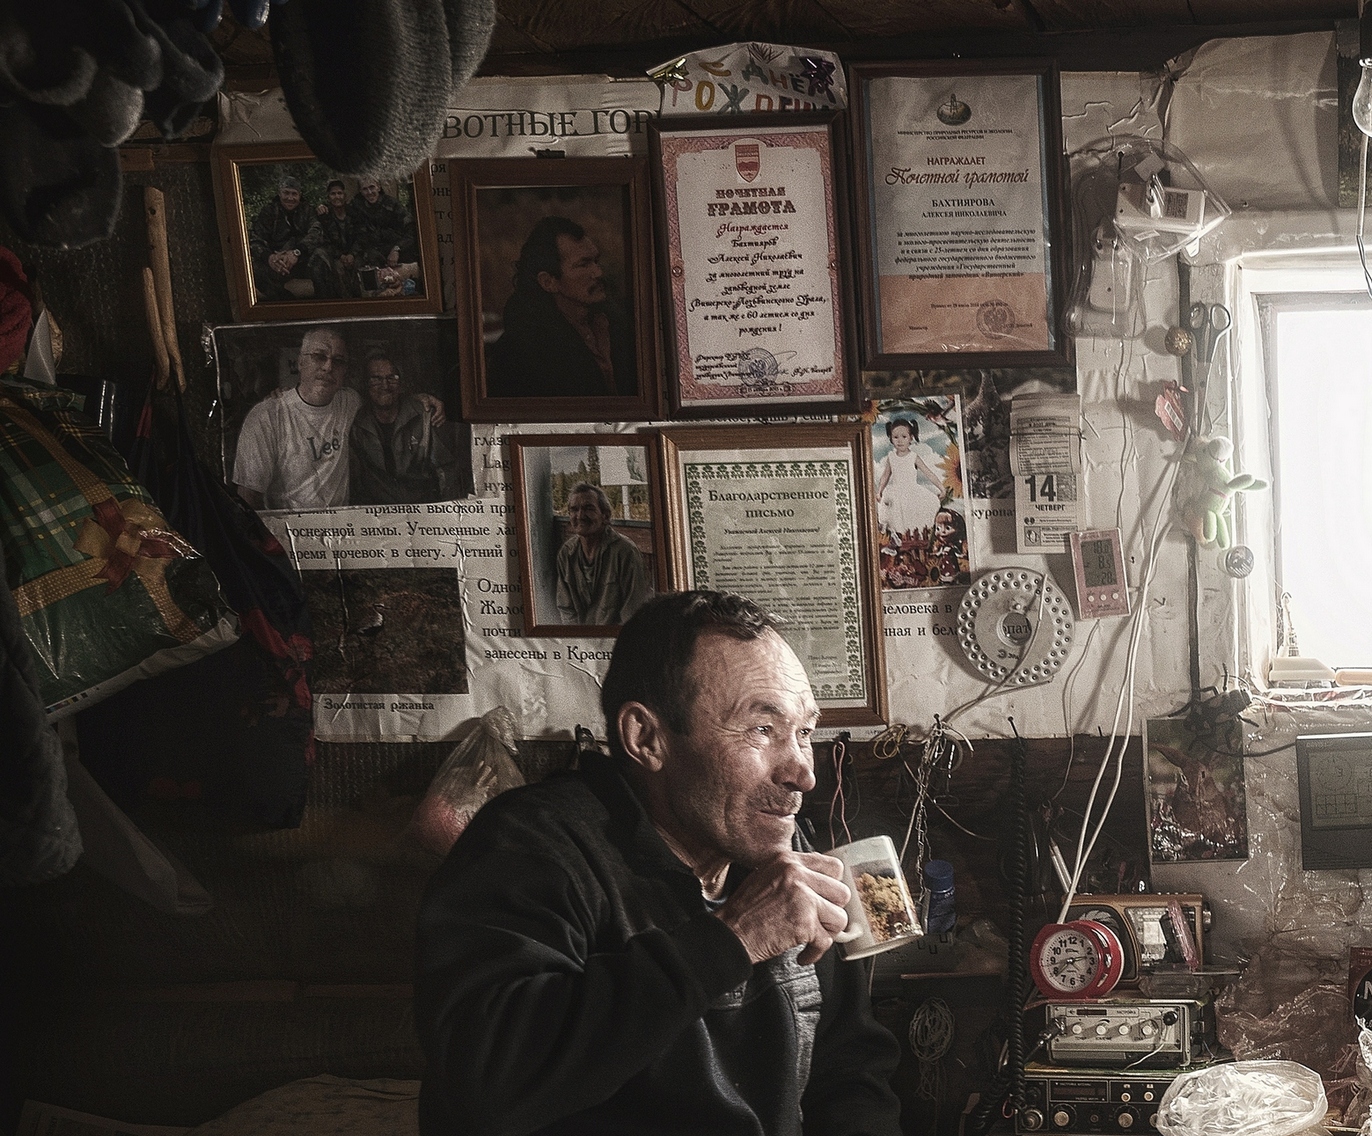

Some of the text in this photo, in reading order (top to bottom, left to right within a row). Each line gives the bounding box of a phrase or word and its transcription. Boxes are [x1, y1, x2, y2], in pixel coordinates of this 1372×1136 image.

[591, 109, 661, 135] ГОР
[926, 156, 986, 166] НАГРАЖДАЕТ
[884, 166, 1030, 189] Почетной грамотой
[715, 186, 786, 199] ПОЧЕТНАЯ
[707, 200, 797, 217] ГРАМОТА
[931, 198, 996, 208] БАХТИЯРОВА
[921, 209, 1008, 219] АЛЕКСЕЯ НИКОЛАЕВИЧА
[715, 221, 789, 240] Награждается
[707, 253, 750, 265] Алексей
[746, 311, 759, 319] 60
[306, 436, 342, 462] Lee
[1024, 475, 1057, 502] 14
[708, 489, 830, 504] Благодарственное
[426, 500, 485, 515] высокой
[745, 507, 795, 519] письмо
[1035, 504, 1066, 512] ЧЕТВЕРГ
[970, 508, 1016, 520] куропа
[360, 526, 402, 538] зимы.
[405, 521, 491, 536] Утепленные
[332, 549, 386, 560] ночевок
[390, 549, 400, 558] в
[404, 549, 446, 562] снегу.
[945, 605, 953, 613] в
[917, 627, 926, 636] и
[484, 648, 548, 661] занесены
[553, 650, 562, 660] в
[323, 699, 435, 713] Золотистая ржанка
[1059, 940, 1067, 948] 11
[1068, 936, 1077, 945] 12
[1052, 947, 1061, 955] 10
